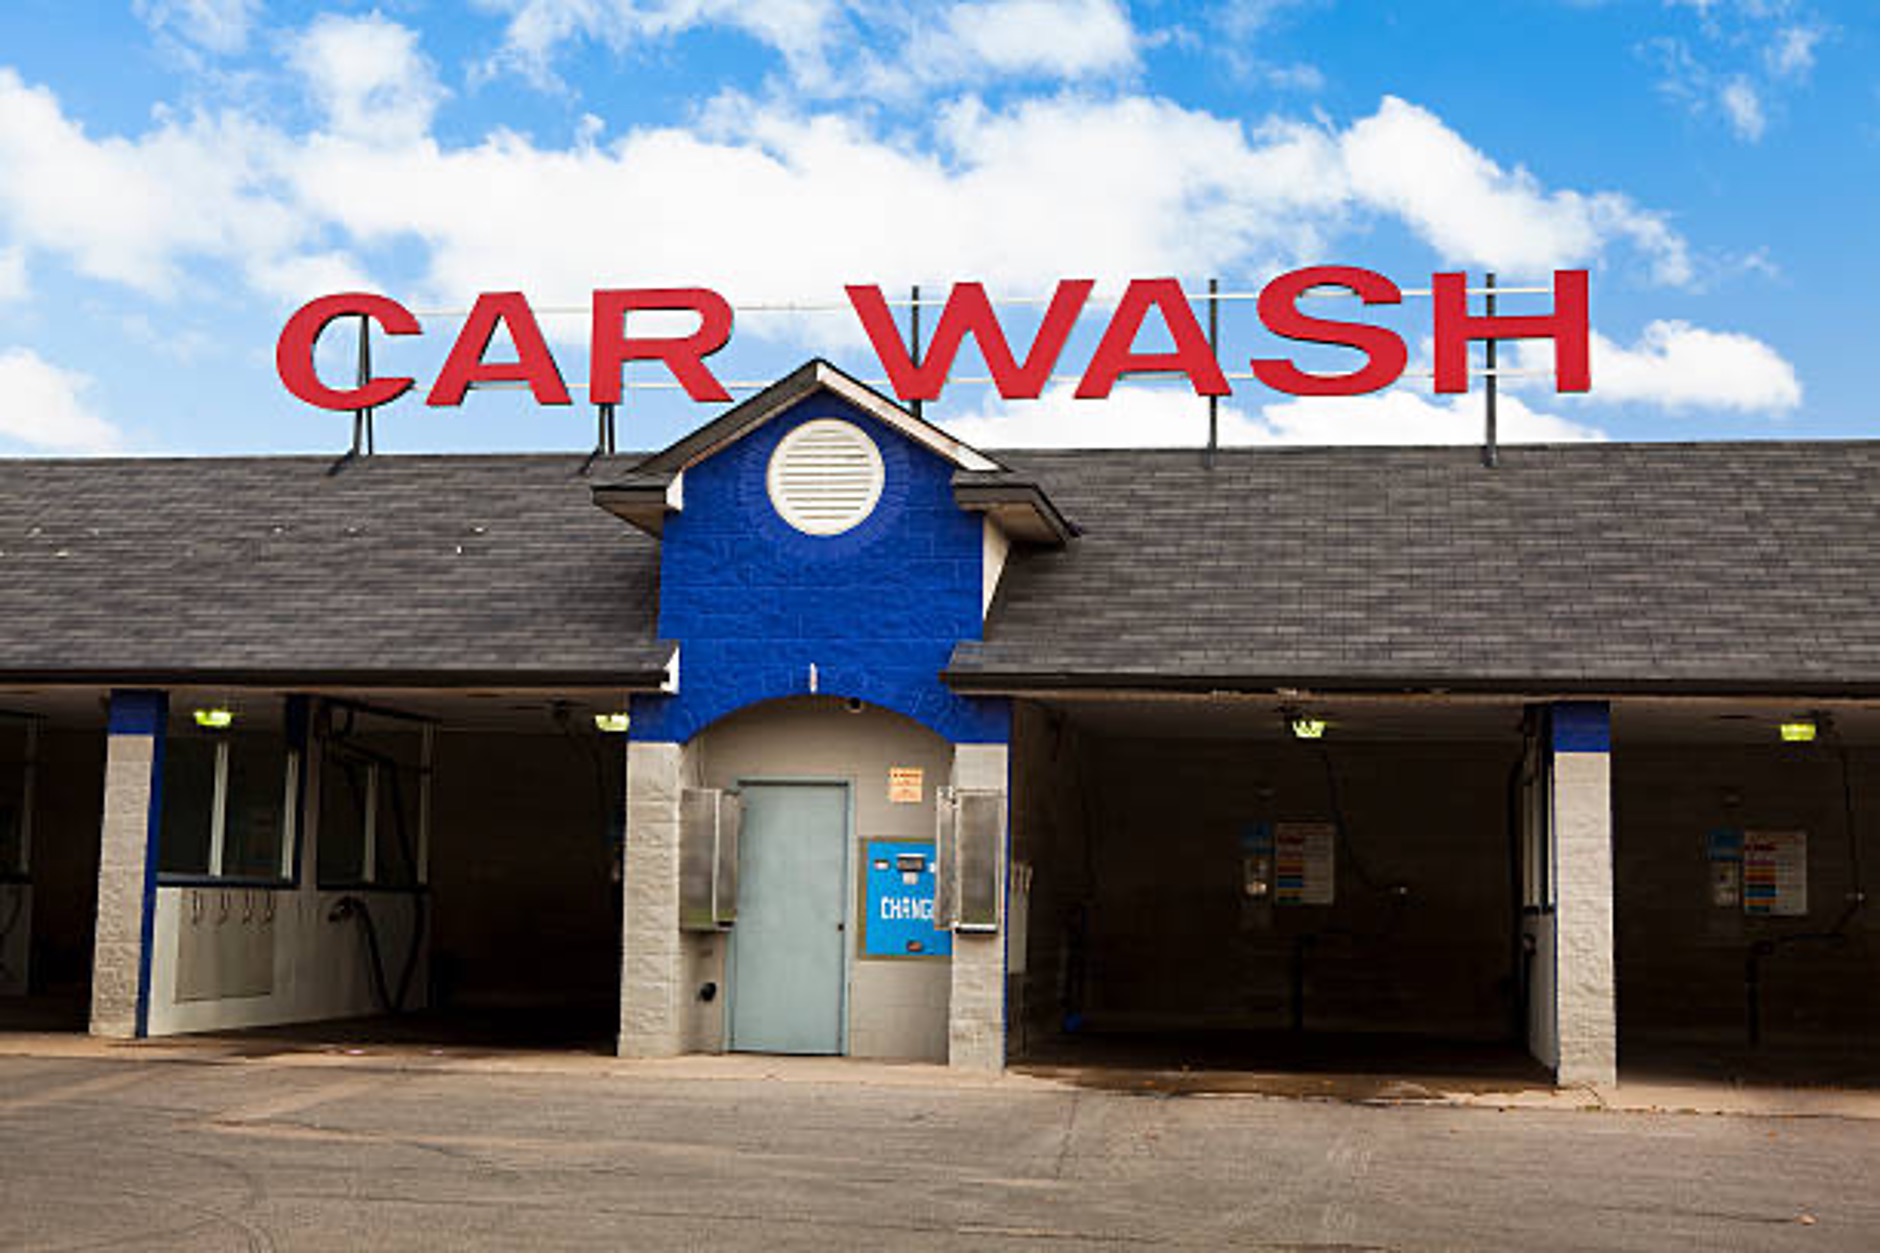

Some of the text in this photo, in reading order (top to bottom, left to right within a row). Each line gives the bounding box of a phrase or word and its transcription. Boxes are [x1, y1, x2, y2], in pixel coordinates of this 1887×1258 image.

[276, 266, 1594, 412] CAR WASH
[880, 896, 935, 920] CHANG
